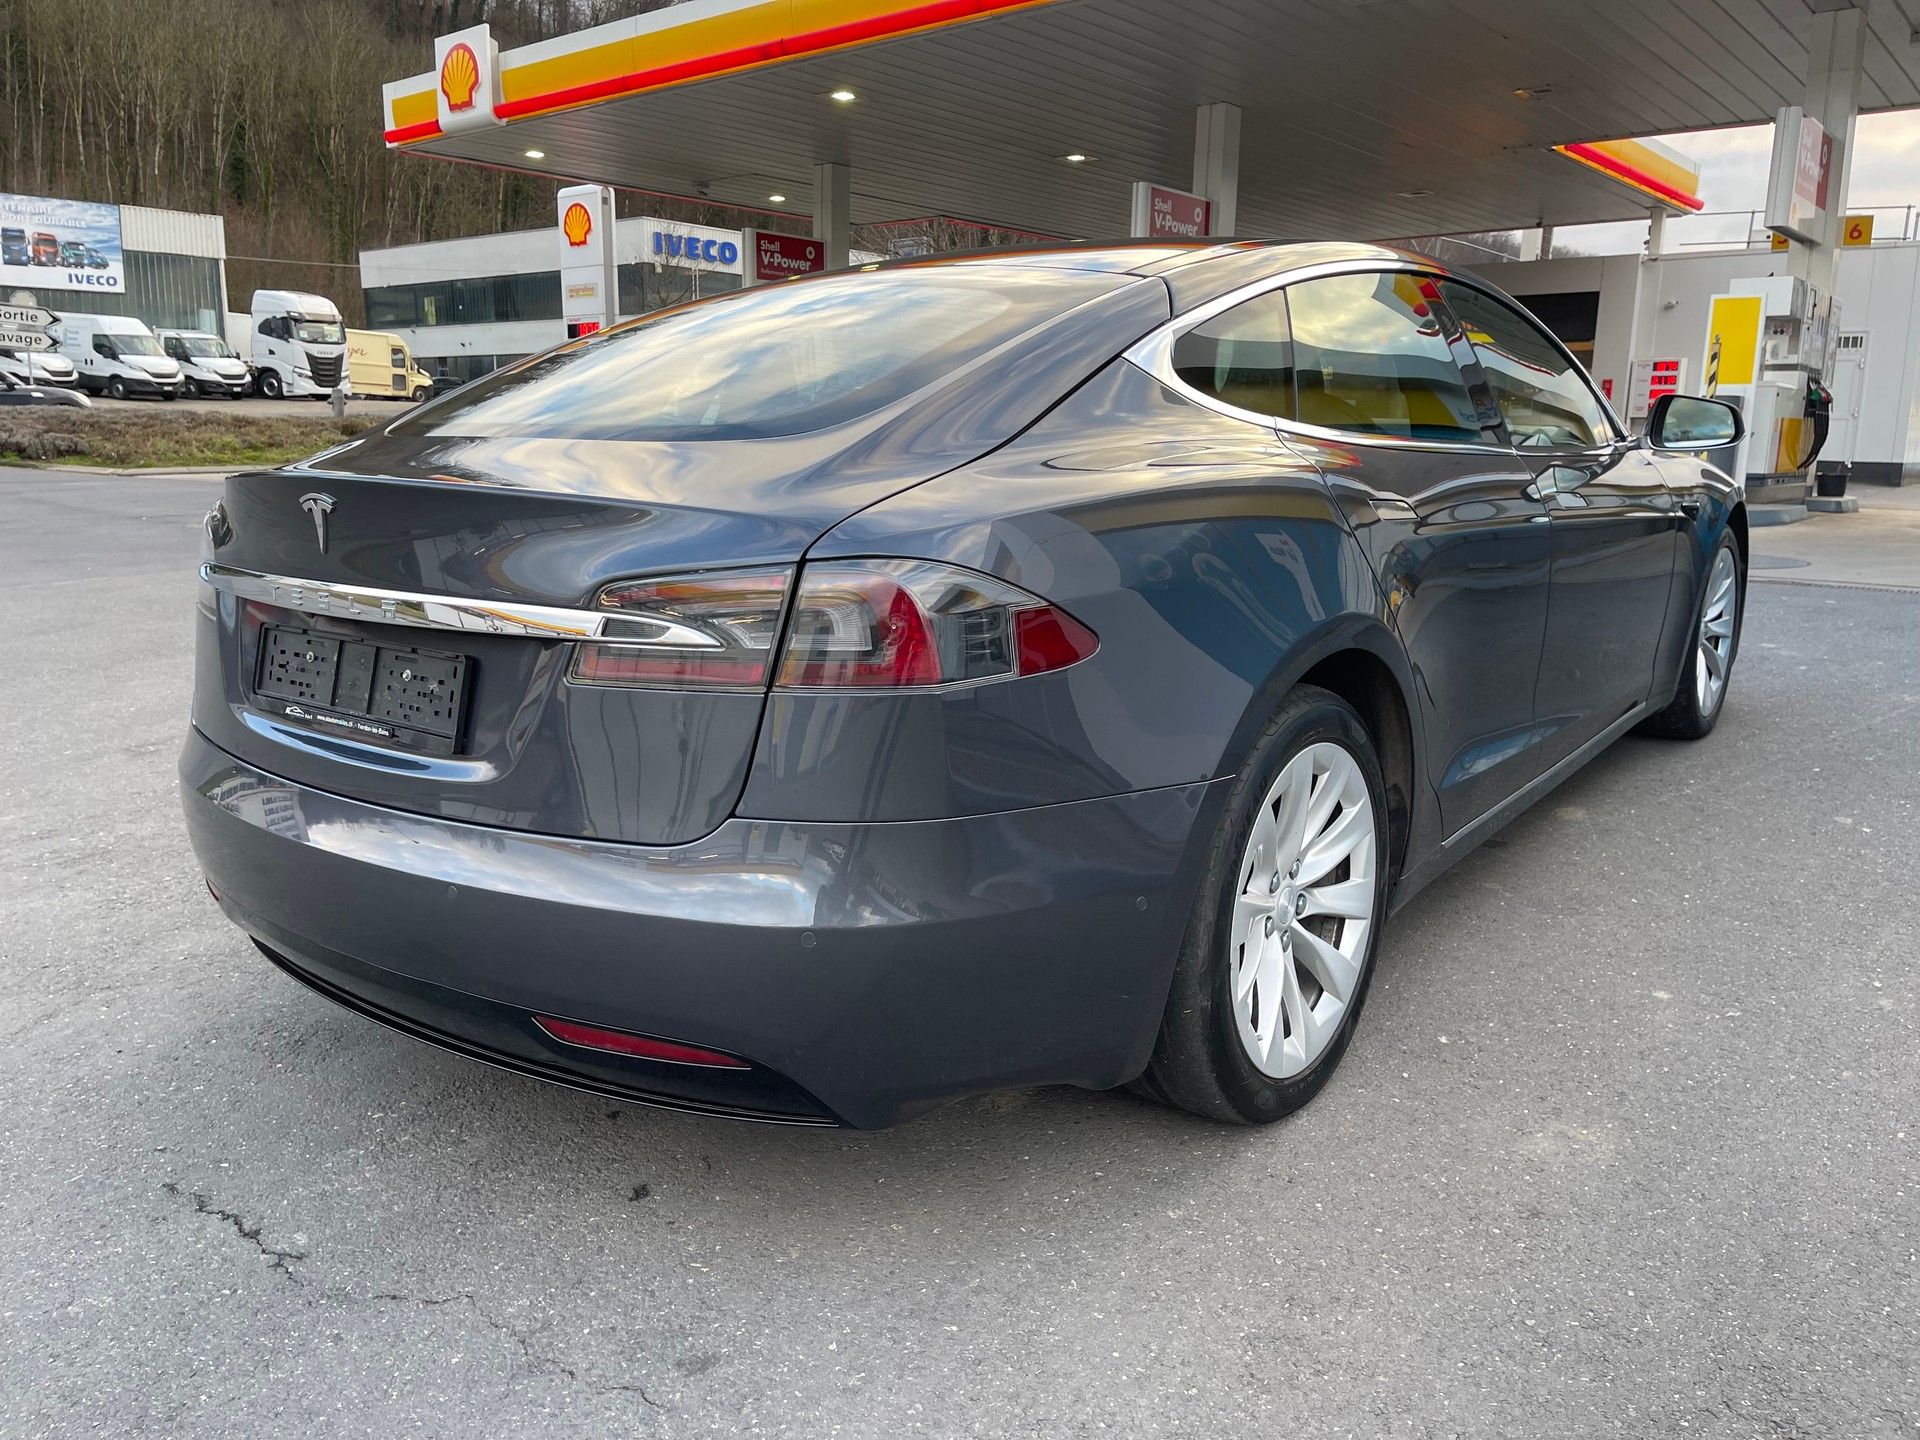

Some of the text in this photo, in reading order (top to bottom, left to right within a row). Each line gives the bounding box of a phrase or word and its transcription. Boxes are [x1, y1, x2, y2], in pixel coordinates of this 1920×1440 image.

[1154, 197, 1172, 213] Shell
[1154, 211, 1198, 237] V-Power
[1849, 223, 1863, 240] 6
[653, 232, 738, 264] IVECO
[760, 239, 780, 252] Shell
[760, 250, 812, 271] V-Power
[67, 272, 118, 287] IVECO
[0, 309, 38, 322] ortie
[270, 583, 397, 620] TESLA
